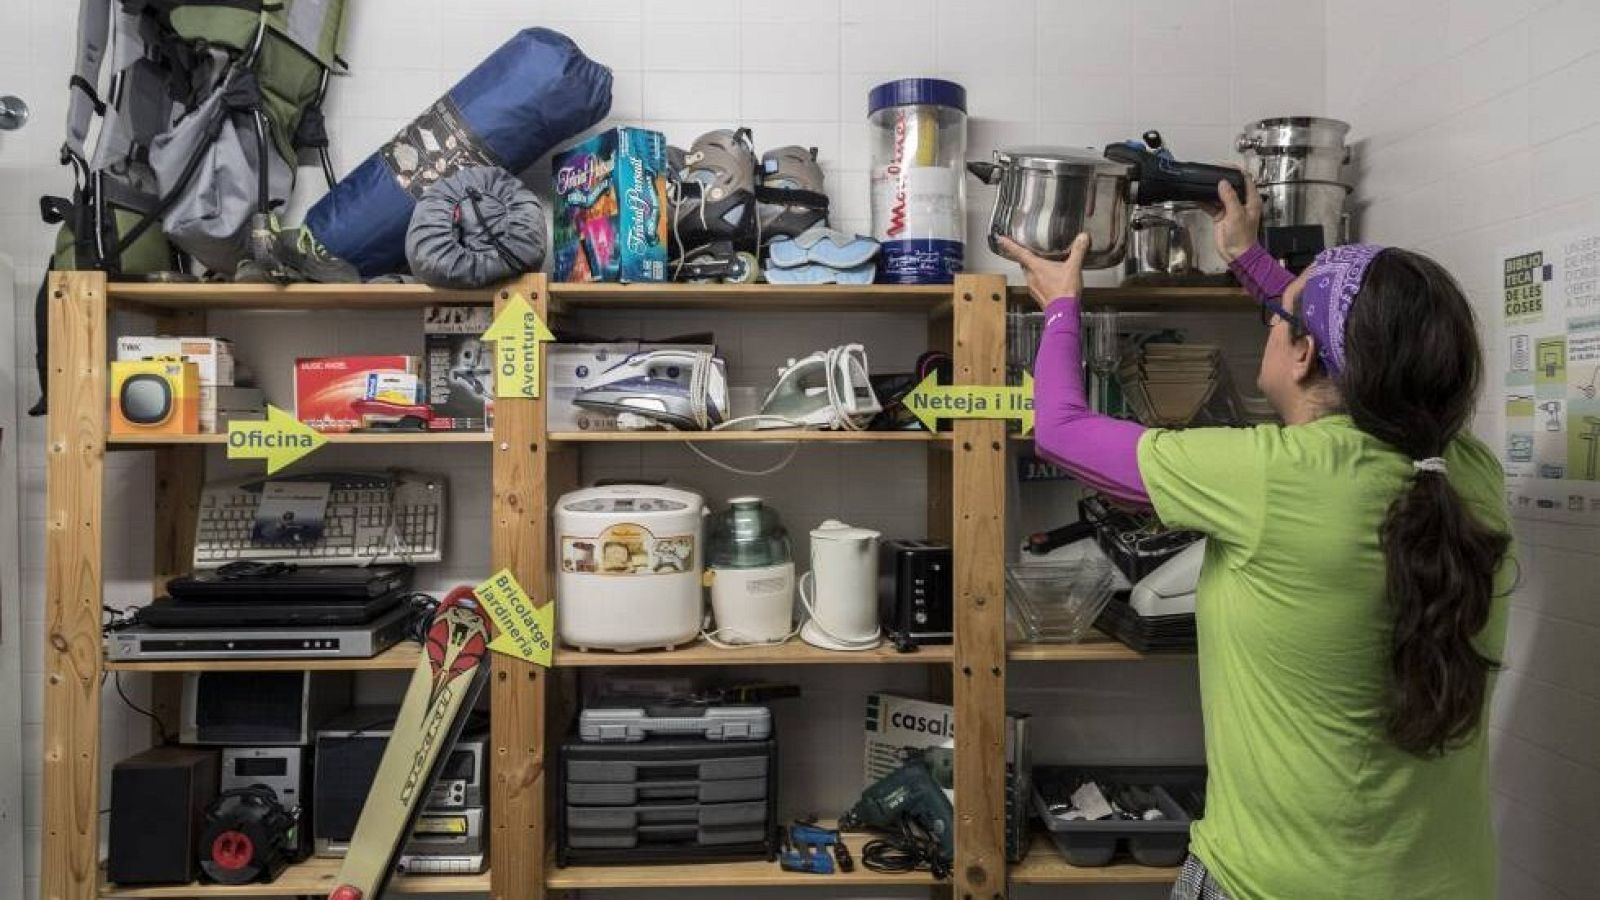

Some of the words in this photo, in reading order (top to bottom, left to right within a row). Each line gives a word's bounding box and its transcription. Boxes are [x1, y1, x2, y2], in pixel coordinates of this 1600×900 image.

[1505, 253, 1541, 272] BIBLIO
[1505, 269, 1532, 286] TECA
[1506, 288, 1519, 301] DE
[1523, 285, 1541, 299] LES
[1506, 299, 1542, 316] COSES
[502, 348, 515, 377] Oci
[521, 311, 534, 396] Aventura
[913, 393, 988, 413] Neteja
[995, 393, 1002, 411] i
[229, 430, 314, 448] Oficina
[480, 586, 533, 656] jardineria
[496, 576, 549, 651] Bricolatge
